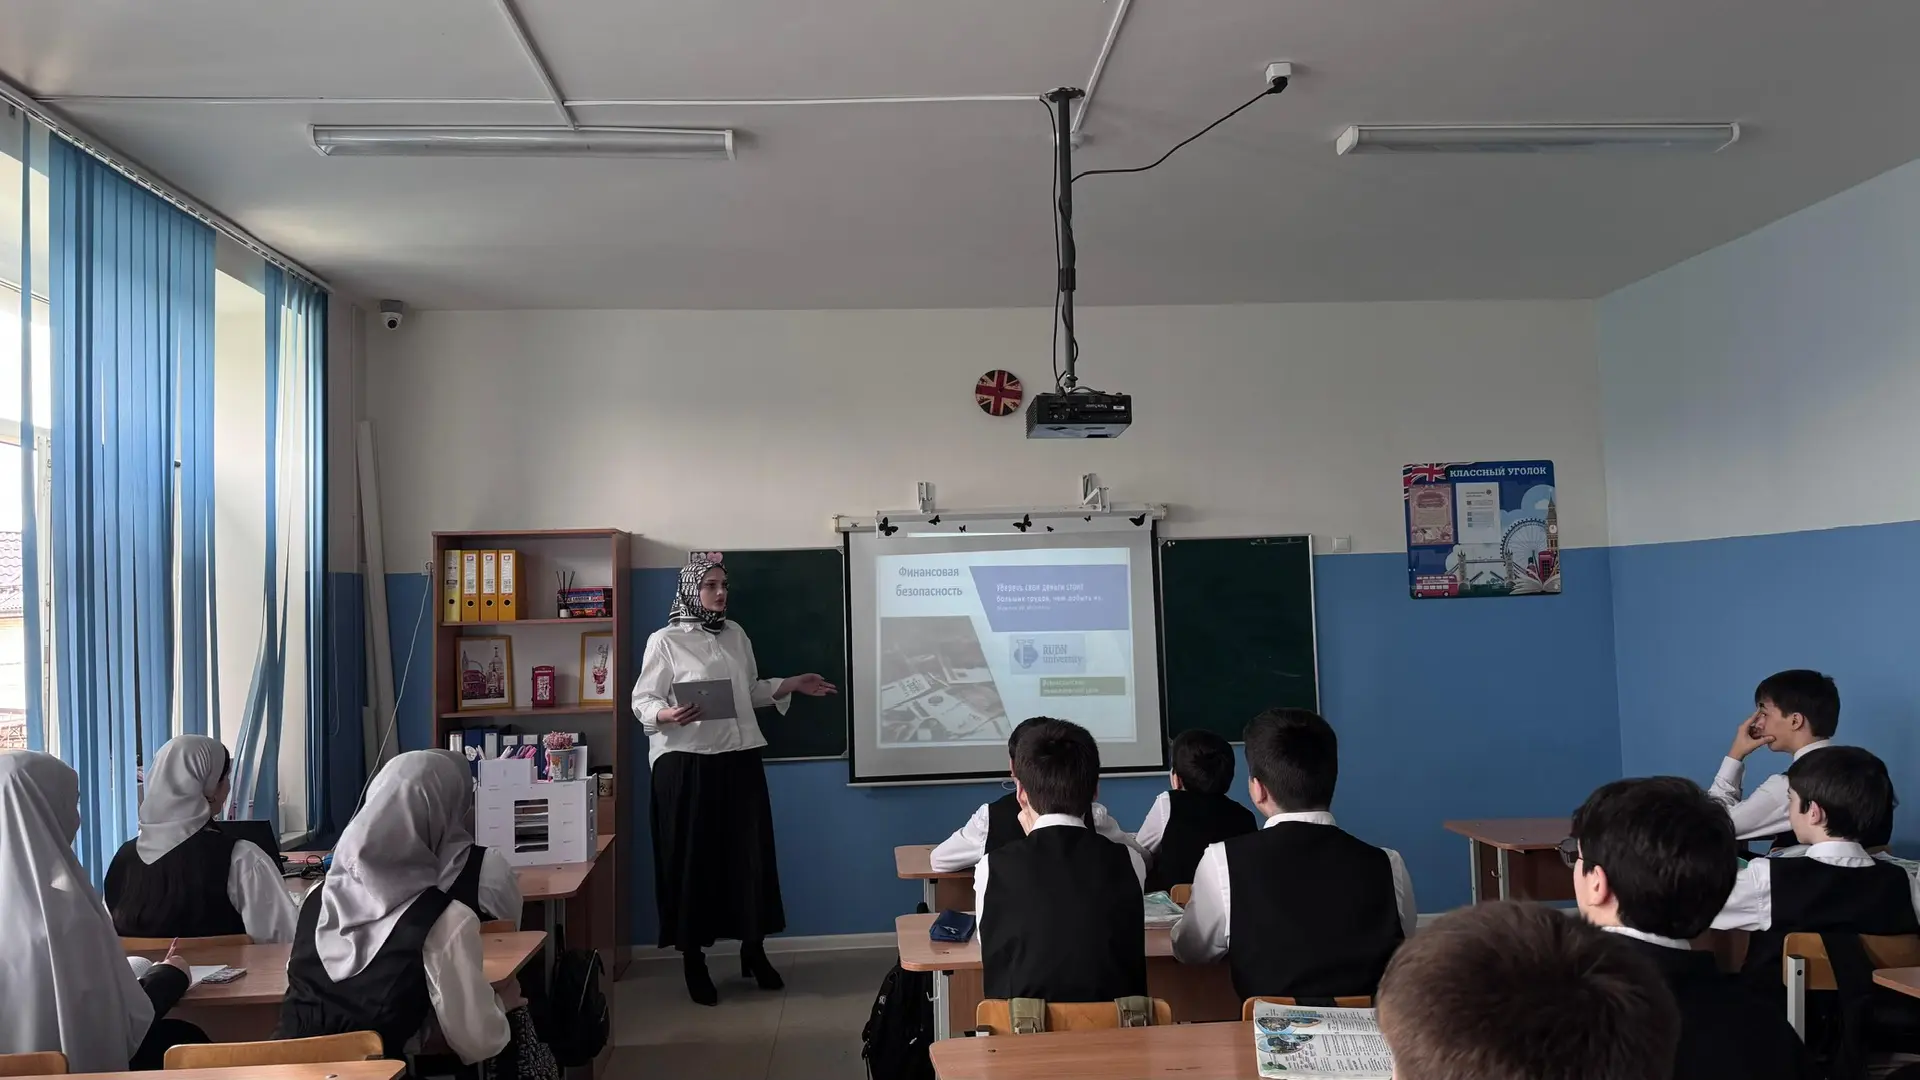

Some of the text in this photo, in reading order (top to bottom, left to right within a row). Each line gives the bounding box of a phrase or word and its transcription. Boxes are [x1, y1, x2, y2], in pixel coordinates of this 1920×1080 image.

[1449, 466, 1547, 477] КЛАССНЫЙ УГОЛОК
[898, 565, 960, 578] Финансовая
[896, 584, 963, 597] безопасность
[1042, 644, 1067, 655] RUDN
[1042, 655, 1083, 665] university
